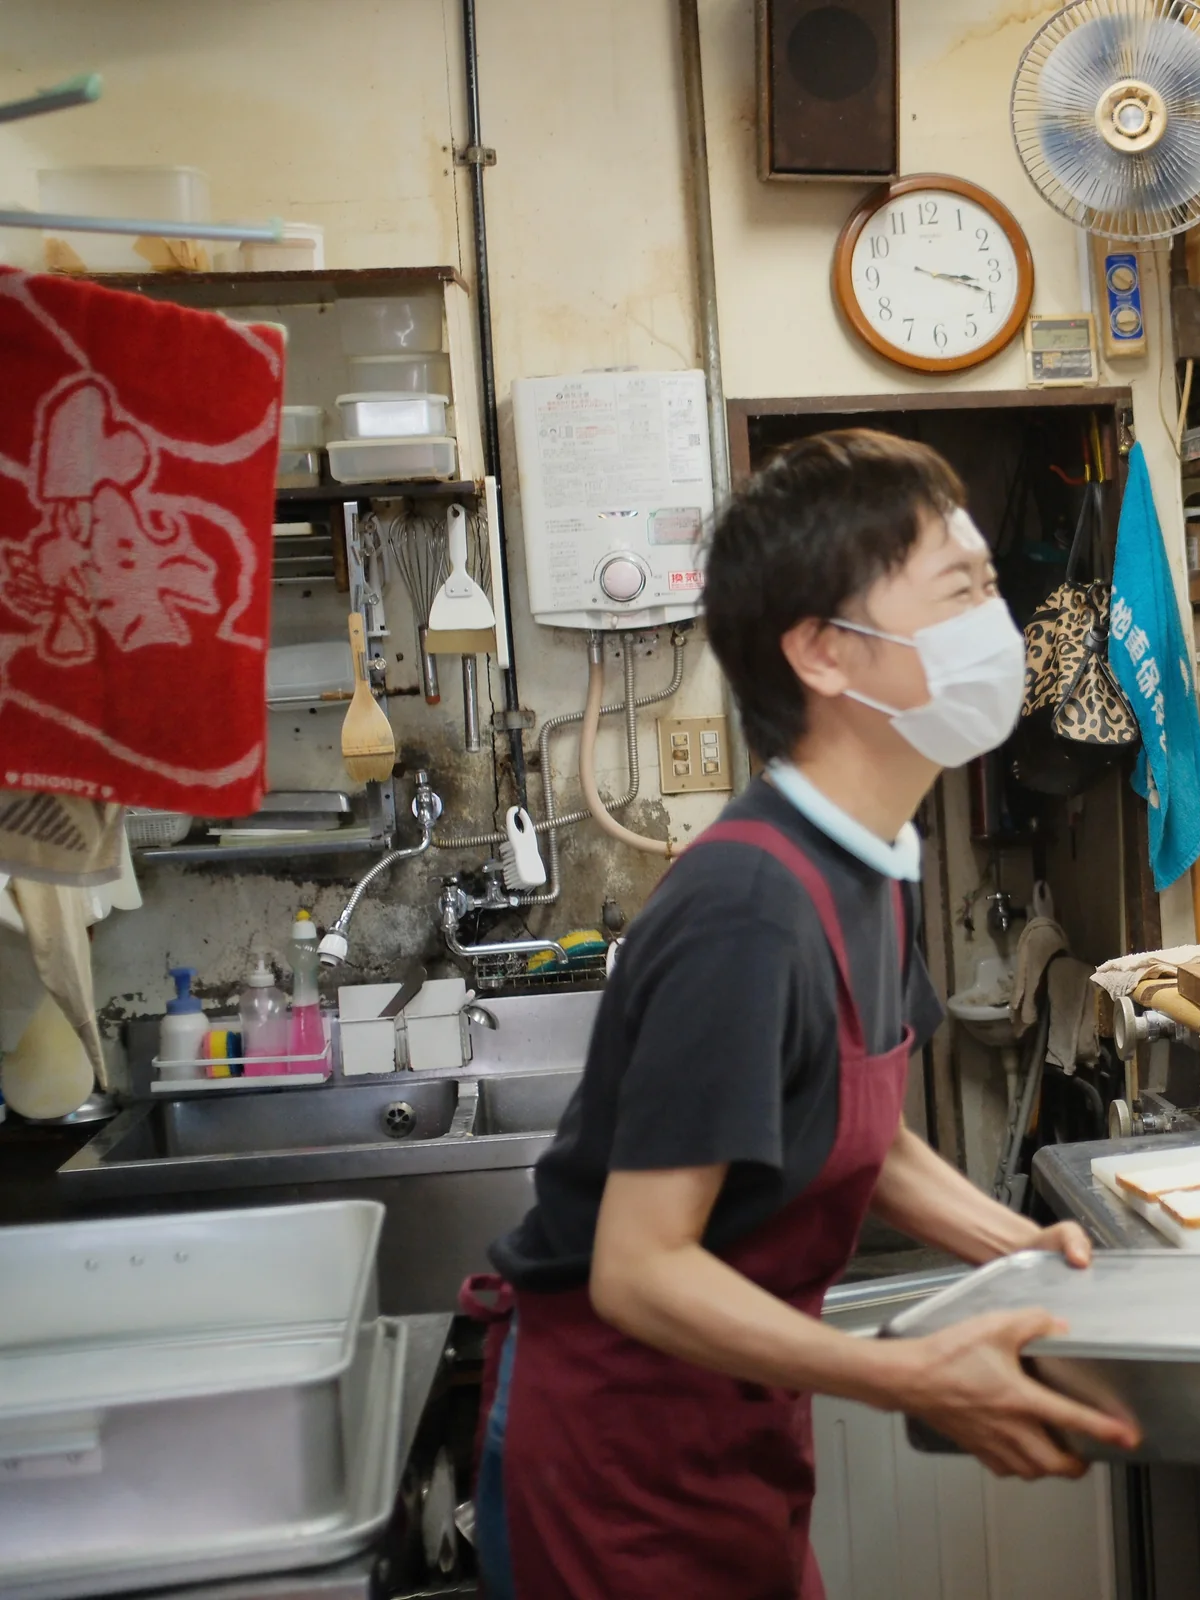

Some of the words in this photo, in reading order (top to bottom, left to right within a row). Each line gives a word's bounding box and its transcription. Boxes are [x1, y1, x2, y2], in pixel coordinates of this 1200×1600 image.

[890, 212, 906, 235] 11
[918, 201, 939, 226] 12
[956, 208, 963, 231] 1
[869, 235, 890, 259] 10
[975, 228, 990, 252] 2
[865, 265, 880, 291] 9
[987, 258, 1002, 283] 3
[878, 296, 893, 322] 8
[983, 291, 996, 314] 4
[902, 318, 914, 342] 7
[933, 323, 948, 348] 6
[964, 313, 978, 338] 5
[22, 773, 99, 796] SNOOPY
